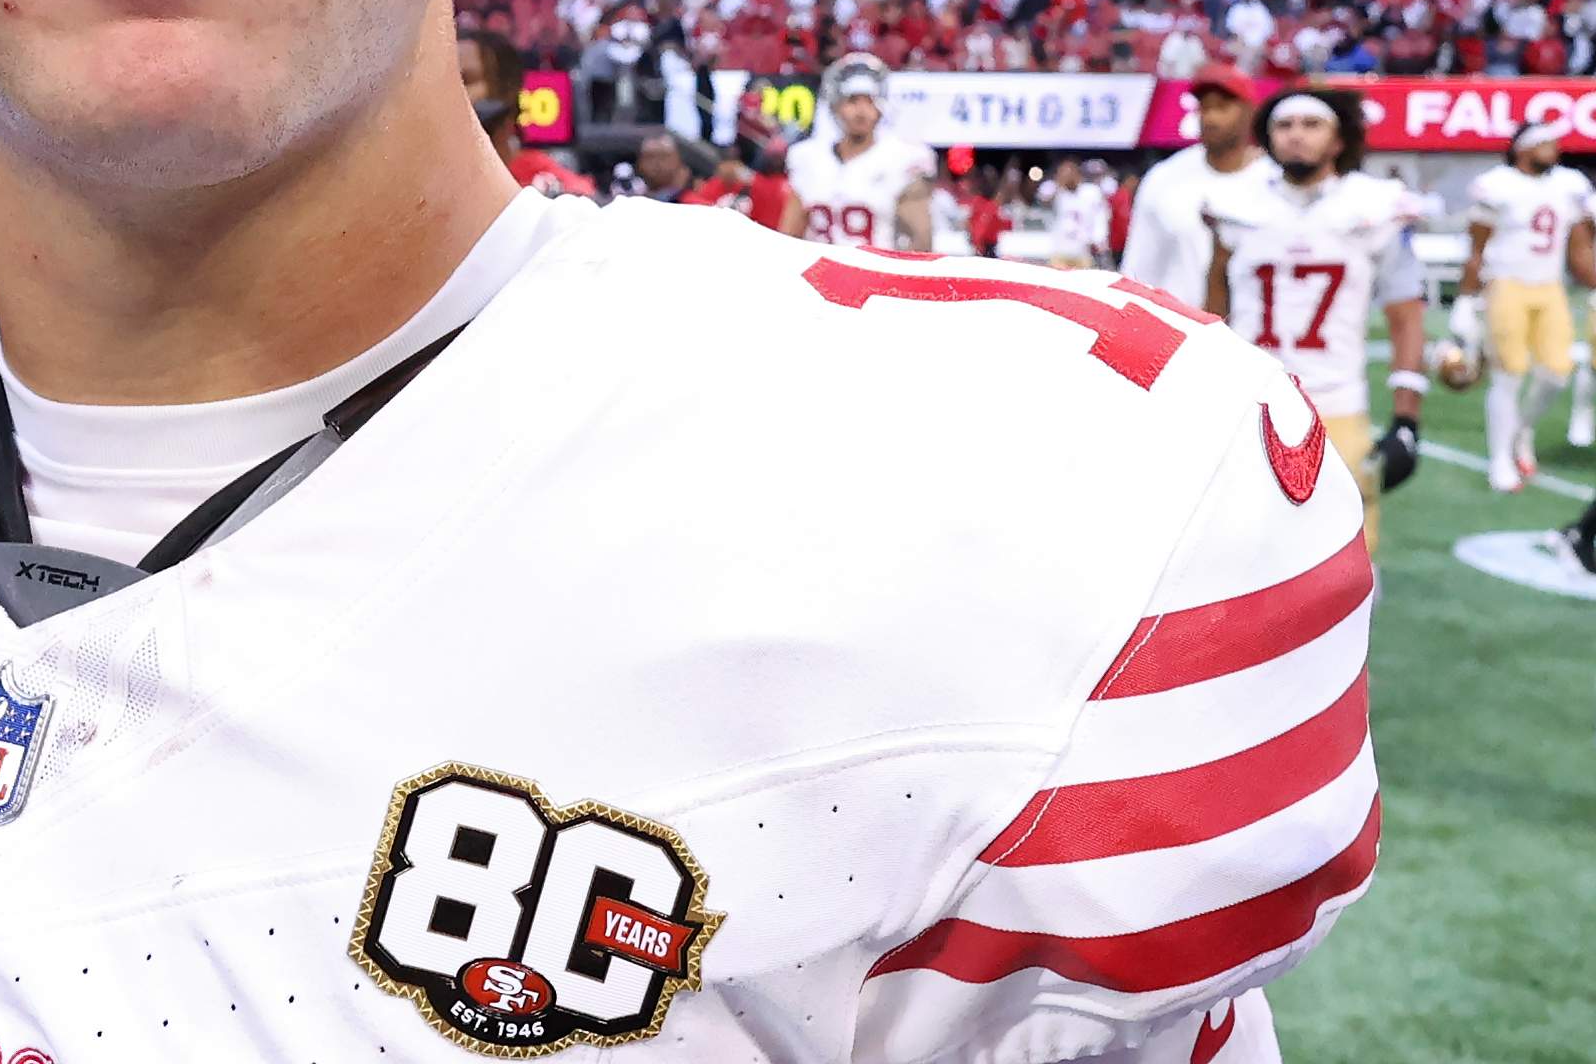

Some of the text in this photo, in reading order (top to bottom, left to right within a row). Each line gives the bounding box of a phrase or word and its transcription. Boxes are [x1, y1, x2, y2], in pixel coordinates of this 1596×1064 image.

[949, 93, 1026, 126] 4TH
[1077, 93, 1121, 128] 13
[1531, 205, 1557, 255] 9
[1255, 262, 1346, 349] 17
[15, 560, 100, 592] XTECH
[376, 783, 682, 1020] 80
[603, 910, 671, 958] YEARS
[483, 965, 539, 1012] SF
[450, 1000, 545, 1038] EST. 1946
